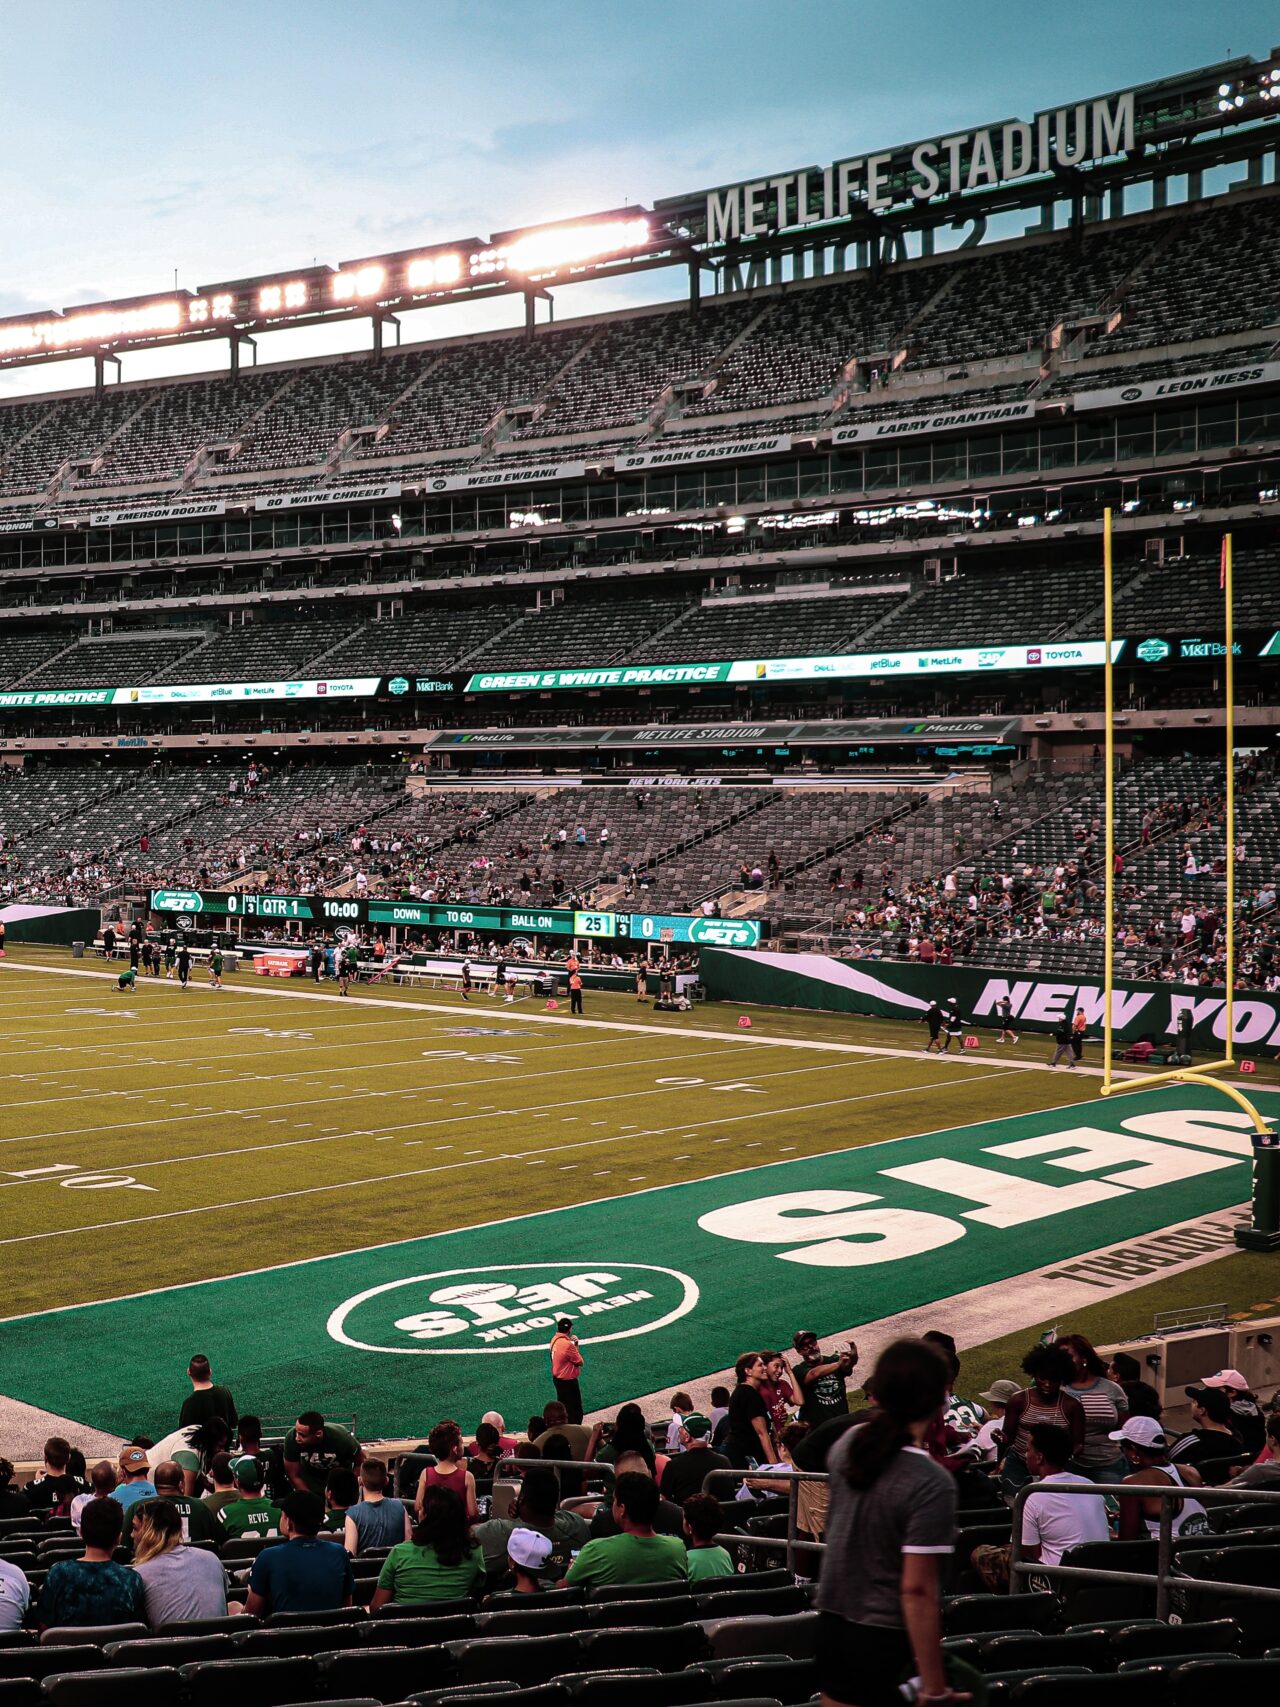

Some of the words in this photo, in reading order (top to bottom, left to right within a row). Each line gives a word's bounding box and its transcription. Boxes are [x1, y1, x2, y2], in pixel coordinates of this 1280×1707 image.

[706, 152, 893, 244] METLIFE
[911, 92, 1136, 200] STADIUM
[1156, 378, 1205, 396] LEON
[1209, 368, 1264, 387] HESS
[836, 428, 859, 441] 60
[877, 419, 931, 436] LARRY
[932, 404, 1029, 430] GRANTHAM
[625, 456, 645, 468] 99
[650, 449, 693, 465] MARK
[696, 439, 778, 460] GASTINEAU
[467, 474, 502, 486] WEEB
[503, 467, 559, 483] EWBANK
[266, 498, 283, 507] 80
[289, 493, 331, 505] WAYNE
[332, 487, 388, 500] CHREBET
[95, 514, 110, 523] 32
[116, 508, 171, 521] EMERSON
[171, 504, 218, 516] BOOZER
[931, 656, 962, 666] MetLife
[1045, 651, 1083, 660] TOYOTA
[870, 658, 901, 670] jetBlue
[479, 675, 539, 689] GREEN
[541, 675, 557, 687] &
[559, 671, 621, 685] WHITE
[622, 666, 721, 683] PRACTICE
[210, 687, 233, 697] jetBlue
[253, 687, 275, 695] MetLife
[329, 684, 354, 692] TOYOTA
[38, 691, 107, 704] PRACTICE
[632, 729, 702, 741] METLIFE
[702, 727, 767, 739] STADIUM
[925, 722, 984, 733] MetLife
[117, 737, 148, 747] MetLife
[470, 733, 516, 742] MetLife
[627, 778, 657, 786] NEW
[657, 777, 689, 786] YORK
[690, 778, 722, 786] JETS
[160, 898, 196, 909] JETS
[227, 896, 237, 912] 0
[245, 895, 257, 903] TOL
[247, 904, 254, 913] 3
[262, 899, 287, 914] QTR
[291, 900, 298, 914] 1
[322, 901, 359, 918] 10:00
[393, 908, 420, 921] DOWN
[446, 911, 460, 922] TO
[460, 911, 473, 923] GO
[511, 914, 532, 927] BALL
[533, 915, 553, 928] ON
[616, 914, 630, 925] TOL
[585, 917, 601, 931] 25
[619, 925, 627, 936] 3
[641, 917, 653, 937] 0
[703, 920, 723, 928] NEW
[723, 921, 746, 929] YORK
[697, 928, 749, 943] JETS
[972, 978, 1155, 1030] NEW
[1241, 1060, 1252, 1072] G
[393, 1271, 623, 1339] JETS
[577, 1289, 655, 1316] NEW
[248, 1512, 269, 1525] REVIS
